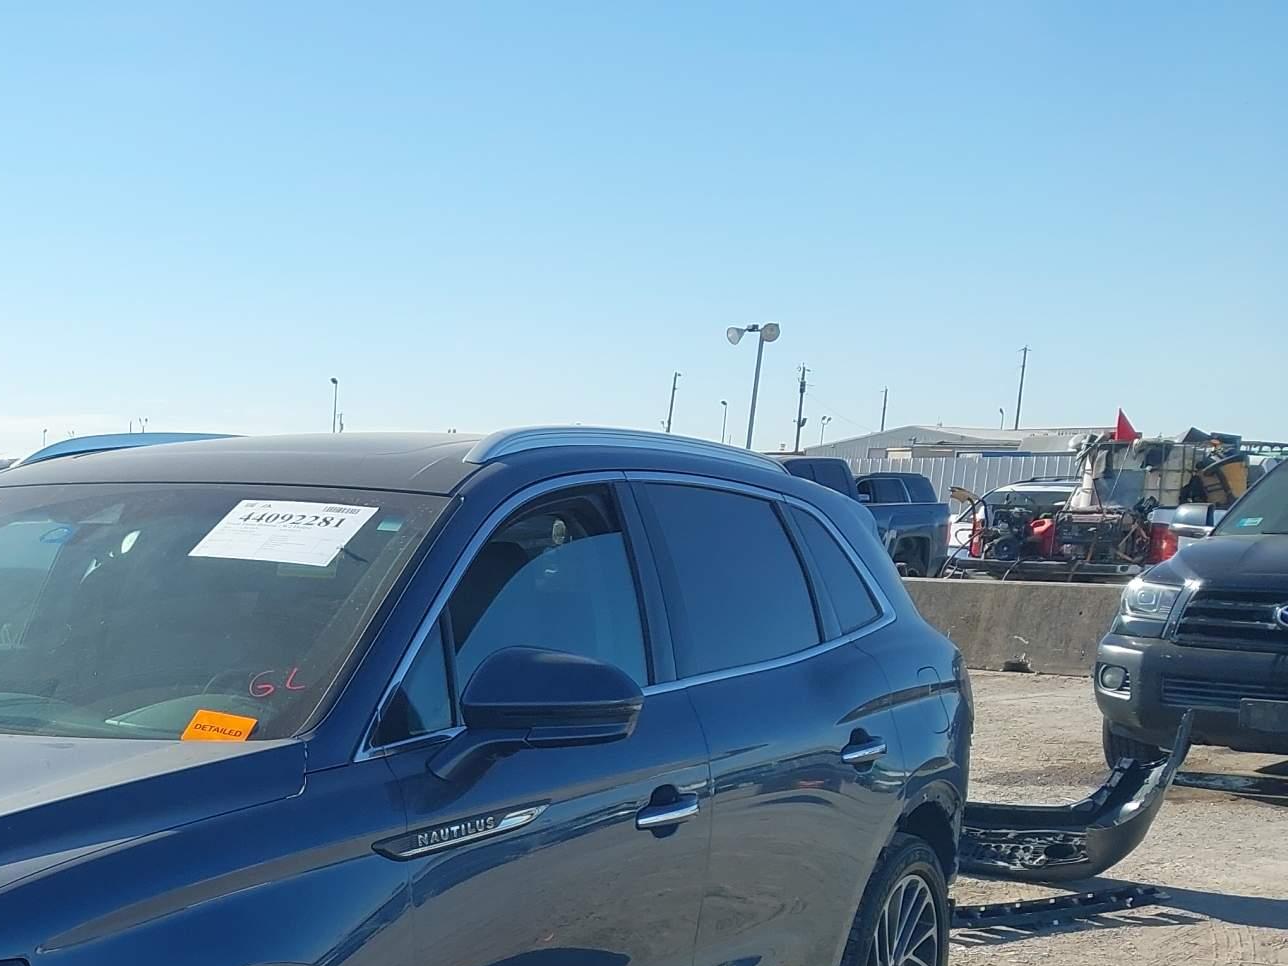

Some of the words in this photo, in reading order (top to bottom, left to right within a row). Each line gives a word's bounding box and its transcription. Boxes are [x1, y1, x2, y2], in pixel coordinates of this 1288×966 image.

[240, 511, 346, 529] 44092281
[194, 723, 242, 737] DETAILED
[417, 816, 495, 847] NAUTILUS
